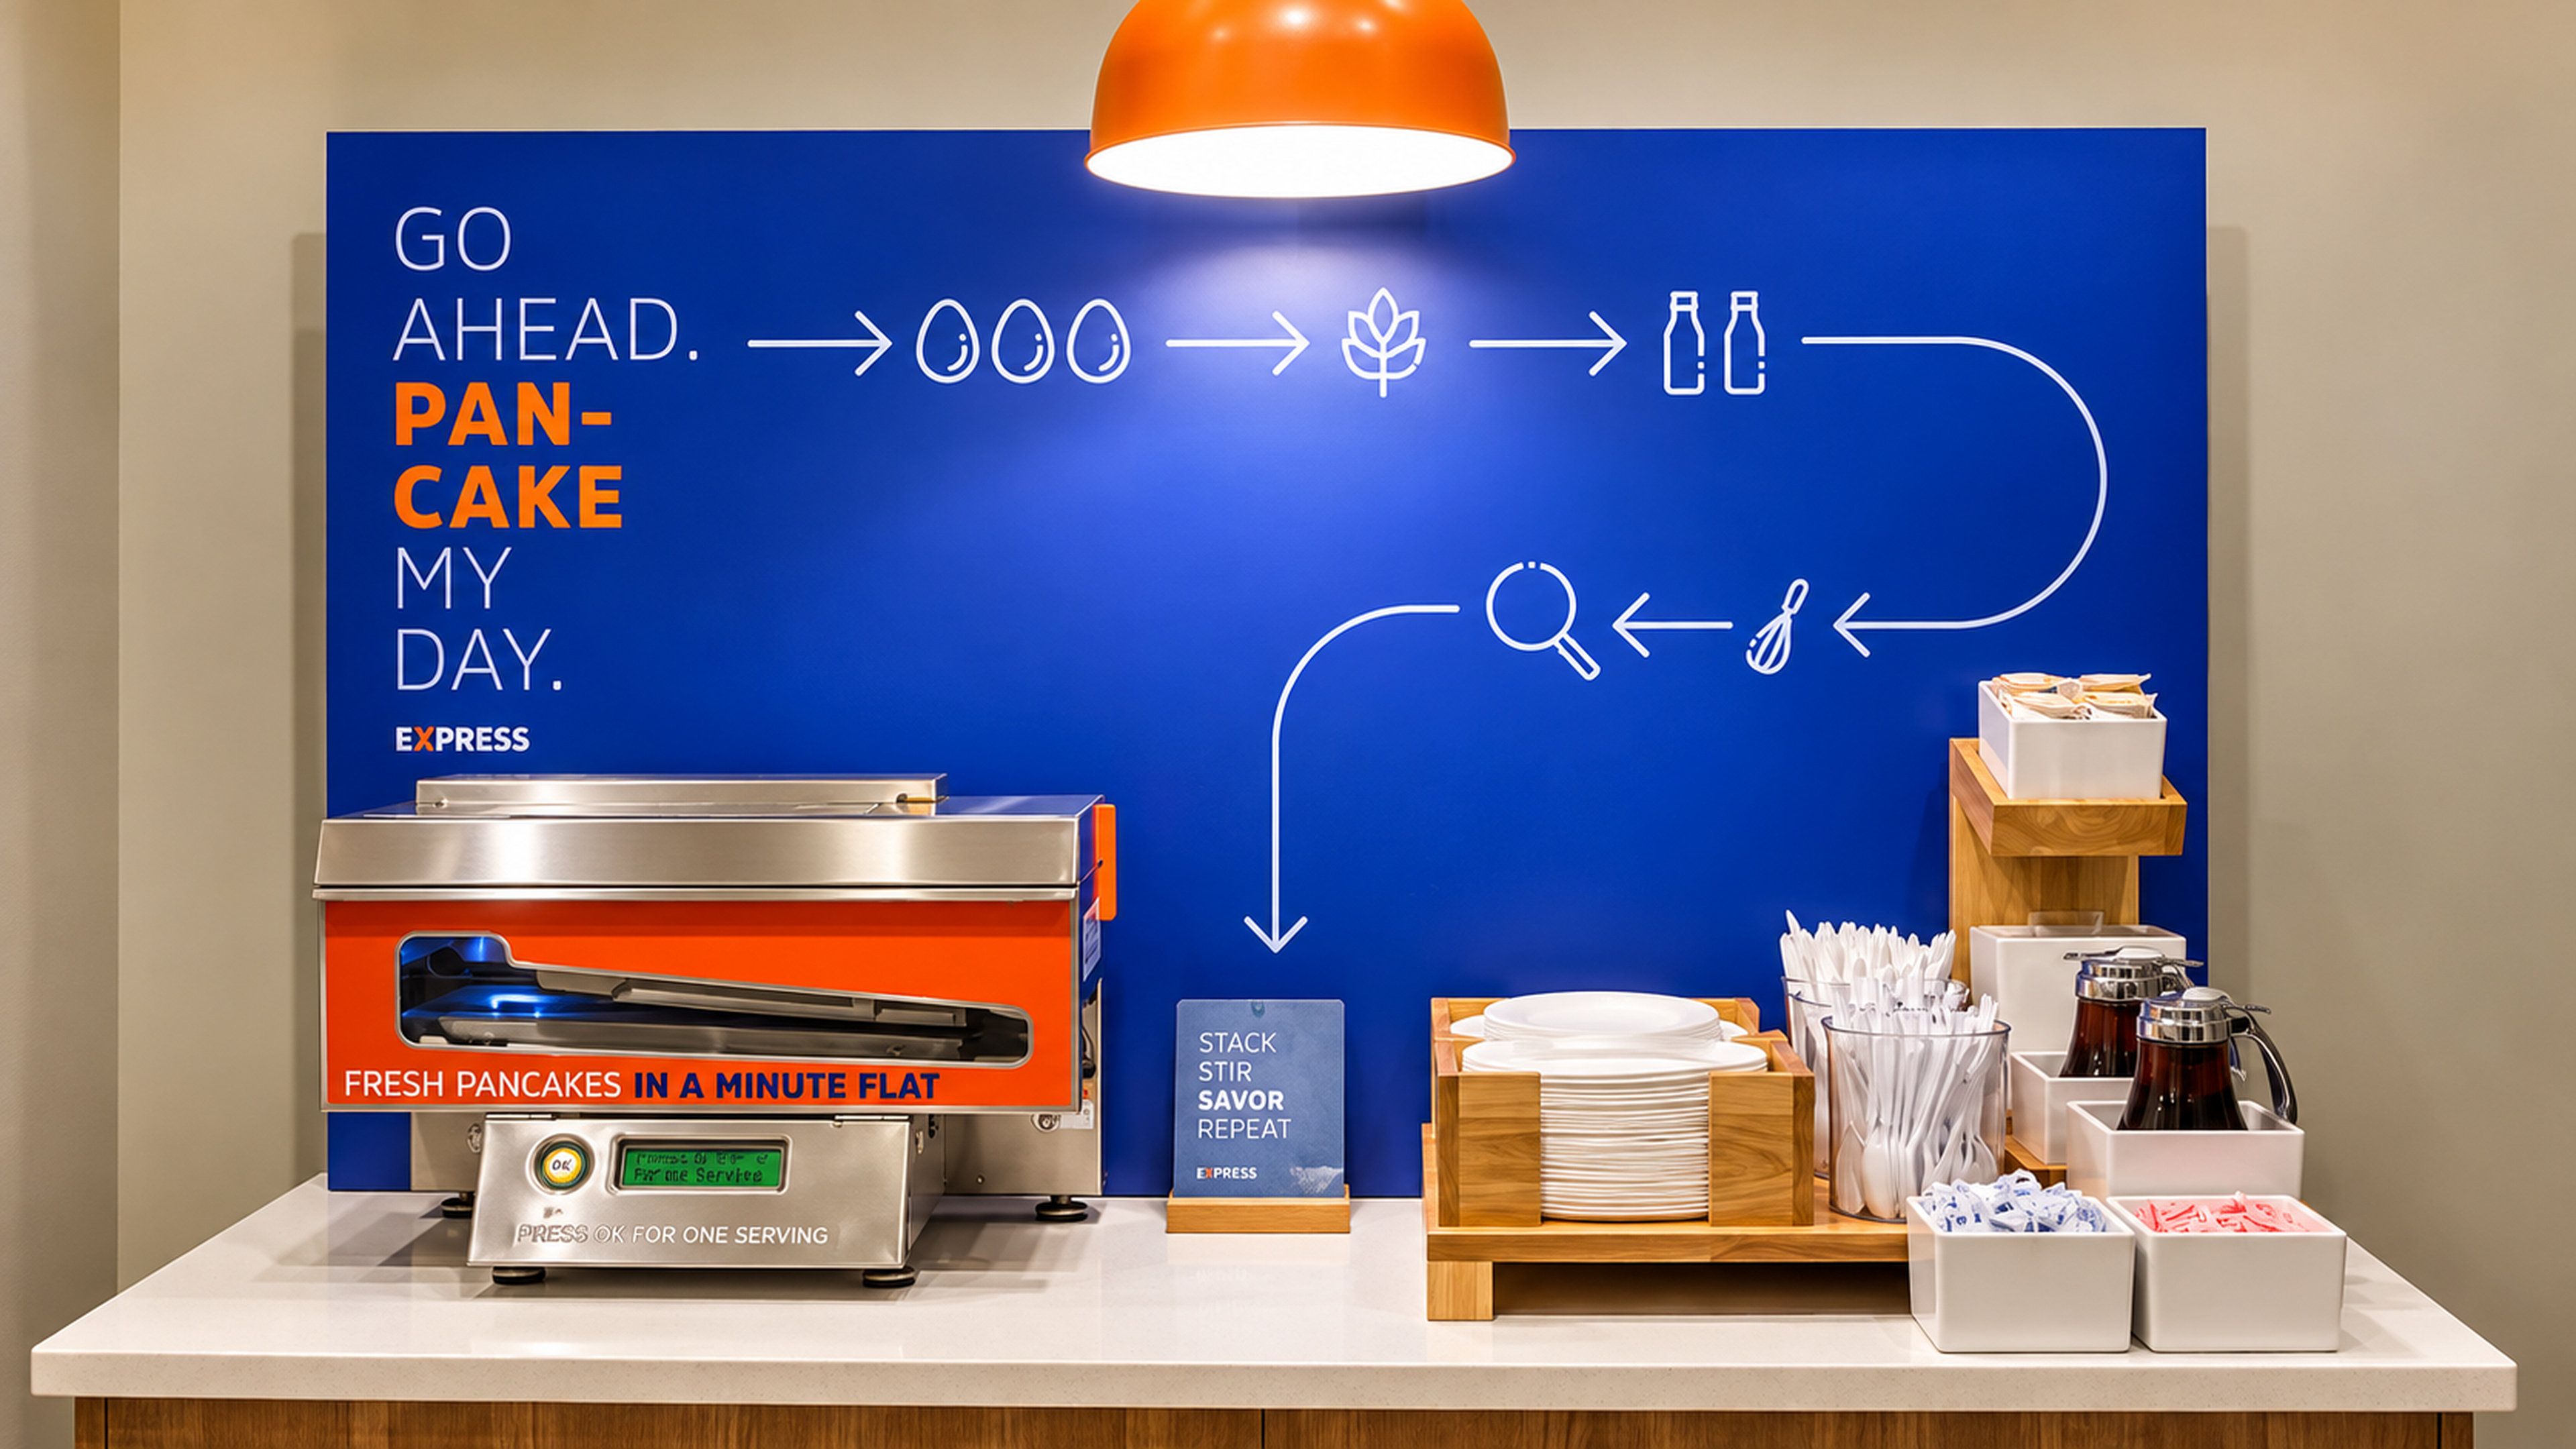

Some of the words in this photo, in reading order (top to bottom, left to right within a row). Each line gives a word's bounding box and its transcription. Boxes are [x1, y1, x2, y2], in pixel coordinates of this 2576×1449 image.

[394, 206, 512, 272] GO
[392, 297, 698, 362] AHEAD.
[395, 381, 612, 446] PAN-
[394, 464, 623, 529] CAKE
[396, 546, 512, 609] MY
[396, 628, 562, 691] DAY.
[396, 726, 530, 752] EXPRESS
[1199, 1032, 1277, 1054] STACK
[1198, 1061, 1252, 1082] STIR
[345, 1070, 443, 1097] FRESH
[457, 1071, 622, 1098] PANCAKES
[634, 1072, 668, 1099] IN
[679, 1072, 705, 1099] A
[716, 1072, 847, 1099] MINUTE
[859, 1073, 941, 1100] FLAT
[1197, 1089, 1285, 1111] SAVOR
[1197, 1118, 1292, 1139] REPEAT
[551, 1159, 573, 1173] OK
[1196, 1167, 1258, 1180] EXPRESS
[517, 1224, 588, 1244] PRESS
[594, 1225, 624, 1244] OK
[632, 1226, 676, 1244] FOR
[682, 1226, 728, 1244] ONE
[735, 1226, 829, 1245] SERVING
